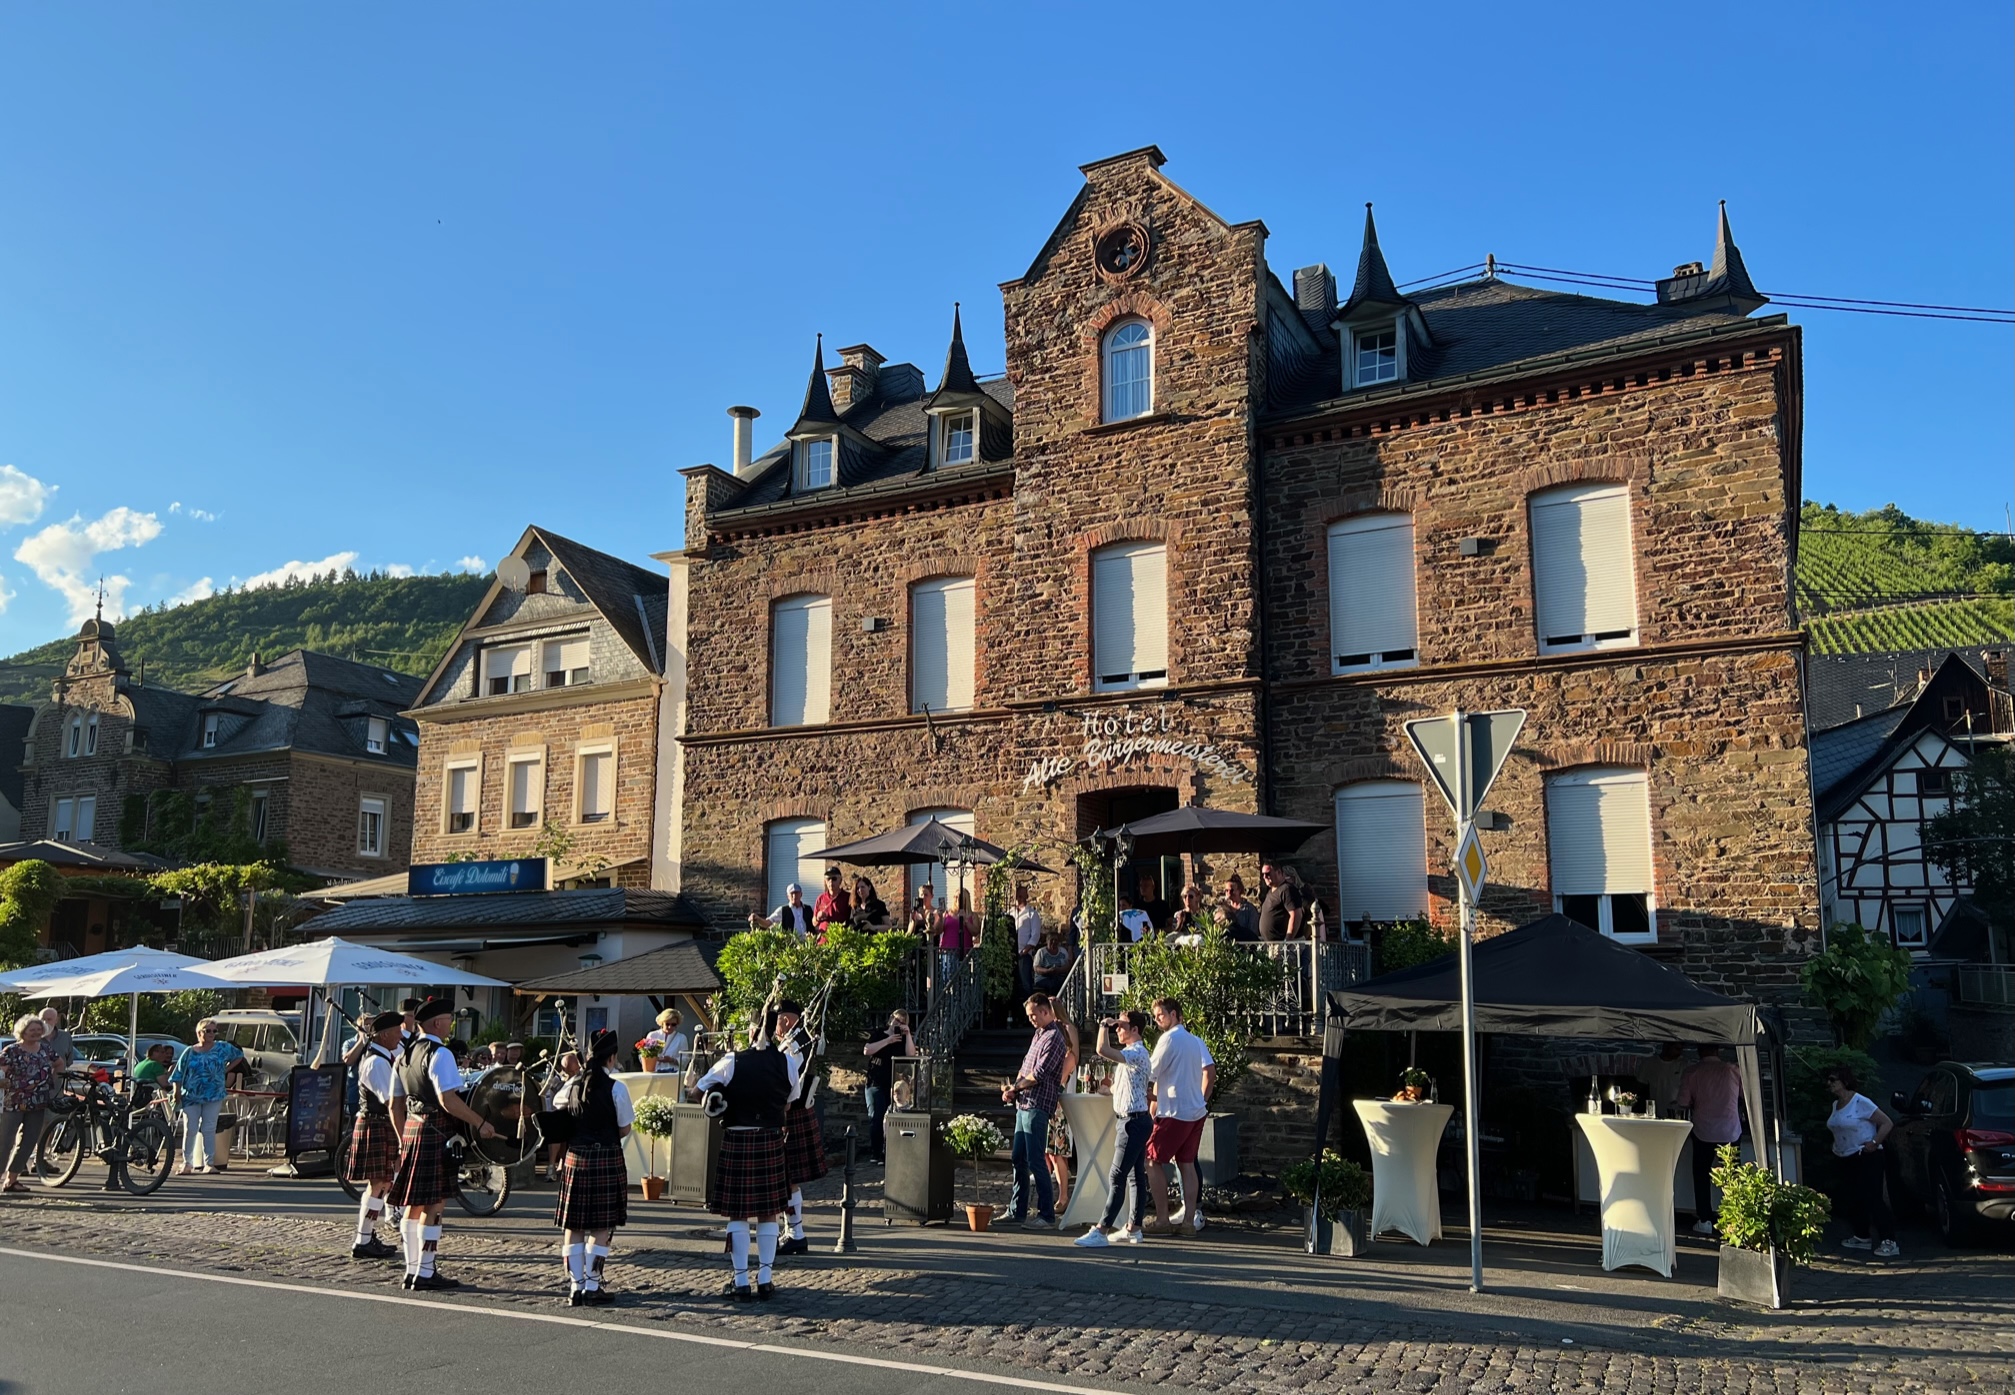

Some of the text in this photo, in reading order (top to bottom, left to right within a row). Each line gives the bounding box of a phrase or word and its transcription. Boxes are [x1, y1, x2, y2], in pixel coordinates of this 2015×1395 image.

[1082, 705, 1170, 737] Hotel
[1023, 736, 1249, 795] Alte Bürgermeisterei
[465, 865, 508, 885] Dolomiti
